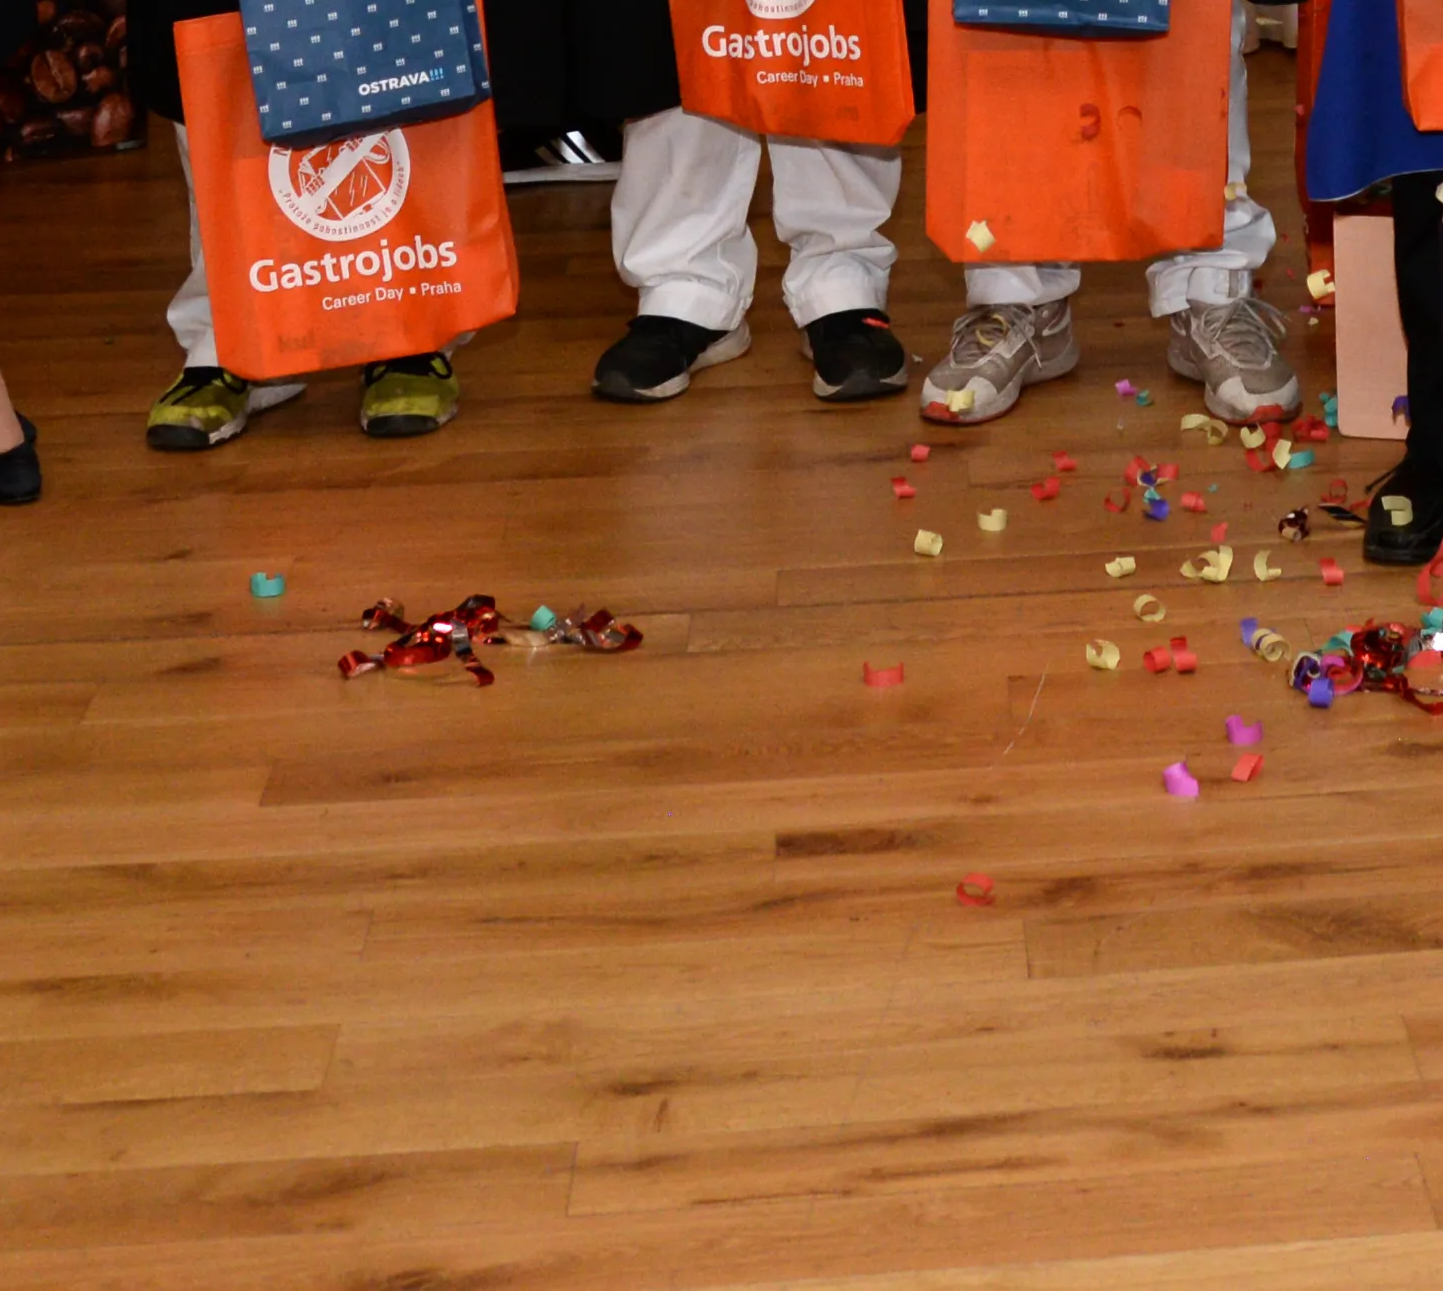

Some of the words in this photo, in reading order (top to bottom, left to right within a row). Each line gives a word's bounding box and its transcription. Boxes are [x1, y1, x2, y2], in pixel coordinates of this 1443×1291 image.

[701, 24, 862, 67] Gastrojobs
[756, 70, 798, 85] Career
[799, 70, 818, 87] Day
[833, 72, 864, 88] Praha
[249, 234, 458, 293] Gastrojobs
[321, 291, 372, 311] Career
[375, 285, 404, 302] Day
[420, 280, 462, 297] Praha
